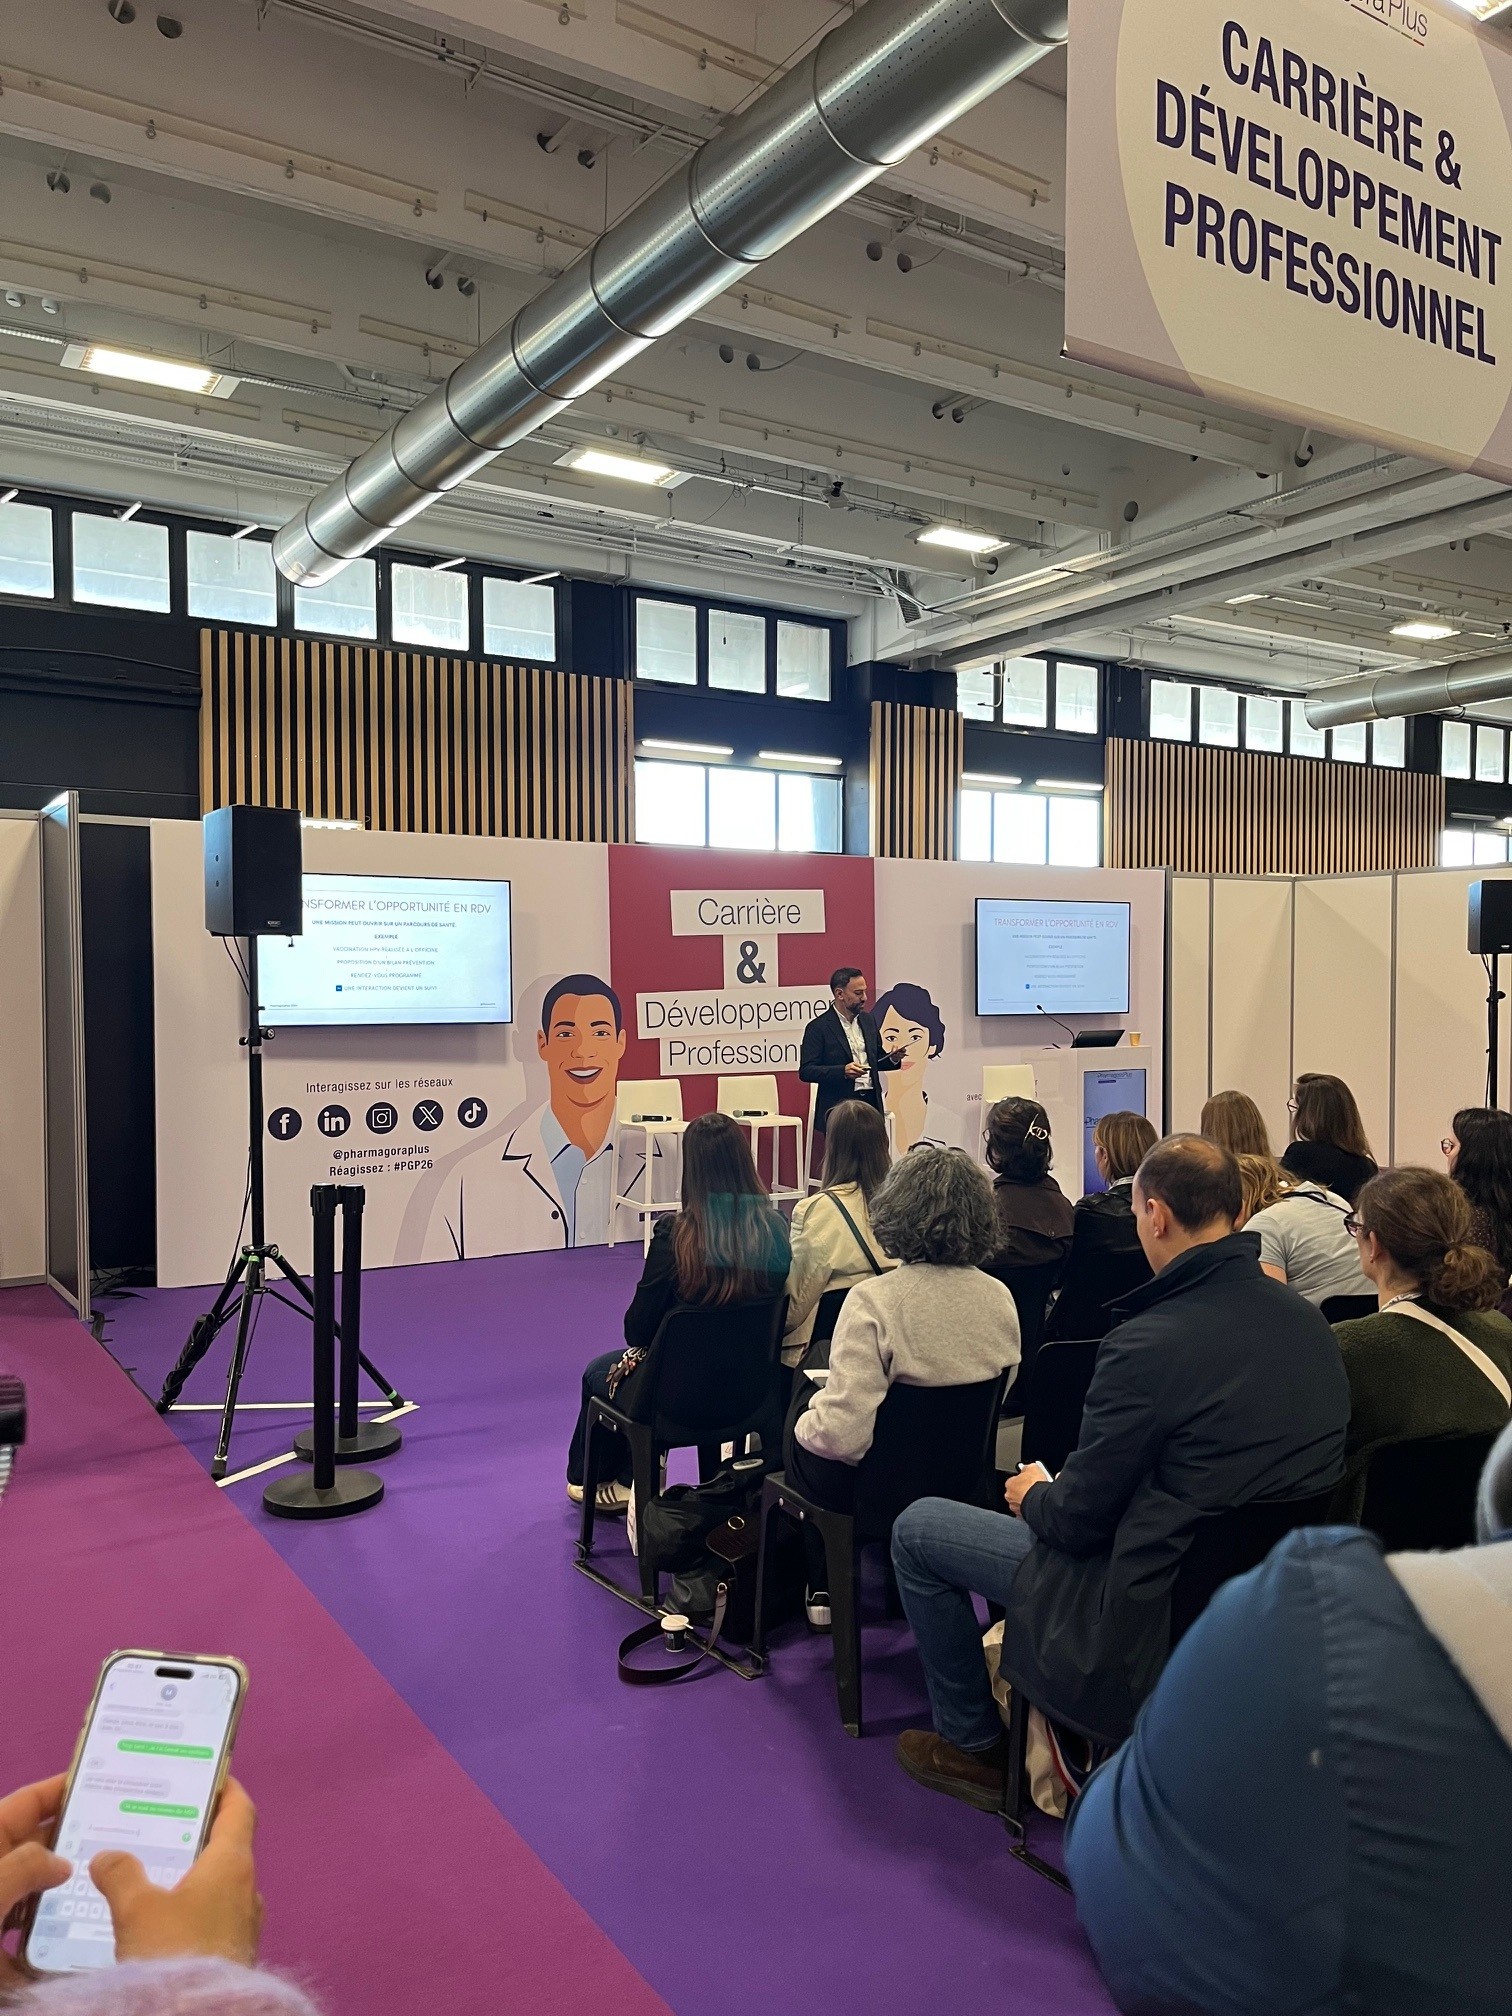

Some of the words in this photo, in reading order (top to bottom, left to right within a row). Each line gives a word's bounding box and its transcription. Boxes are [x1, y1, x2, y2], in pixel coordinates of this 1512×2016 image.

[1221, 19, 1424, 173] CARRIÈRE
[1434, 129, 1463, 191] &
[1156, 78, 1502, 286] DÉVELOPPEMENT
[1164, 181, 1497, 366] PROFESSIONNEL
[302, 898, 366, 911] NSFORMER
[369, 899, 450, 913] L'OPPORTUNITÉ
[453, 902, 468, 913] EN
[470, 903, 492, 914] RDV
[697, 896, 801, 926] Carrière
[311, 919, 324, 927] UNE
[324, 919, 348, 927] MISSION
[994, 917, 1044, 929] TRANSFORMER
[1095, 919, 1104, 929] EN
[1105, 919, 1118, 929] RDV
[736, 940, 767, 984] &
[645, 997, 836, 1030] Développeme
[669, 1038, 803, 1067] Profession
[305, 1081, 371, 1095] Interagissez
[374, 1080, 391, 1091] sur
[395, 1078, 410, 1090] les
[413, 1077, 454, 1089] réseaux
[966, 1093, 983, 1102] avec
[332, 1145, 430, 1161] @pharmagoraplus
[329, 1162, 384, 1178] Réagissez
[393, 1159, 434, 1173] #PGP26
